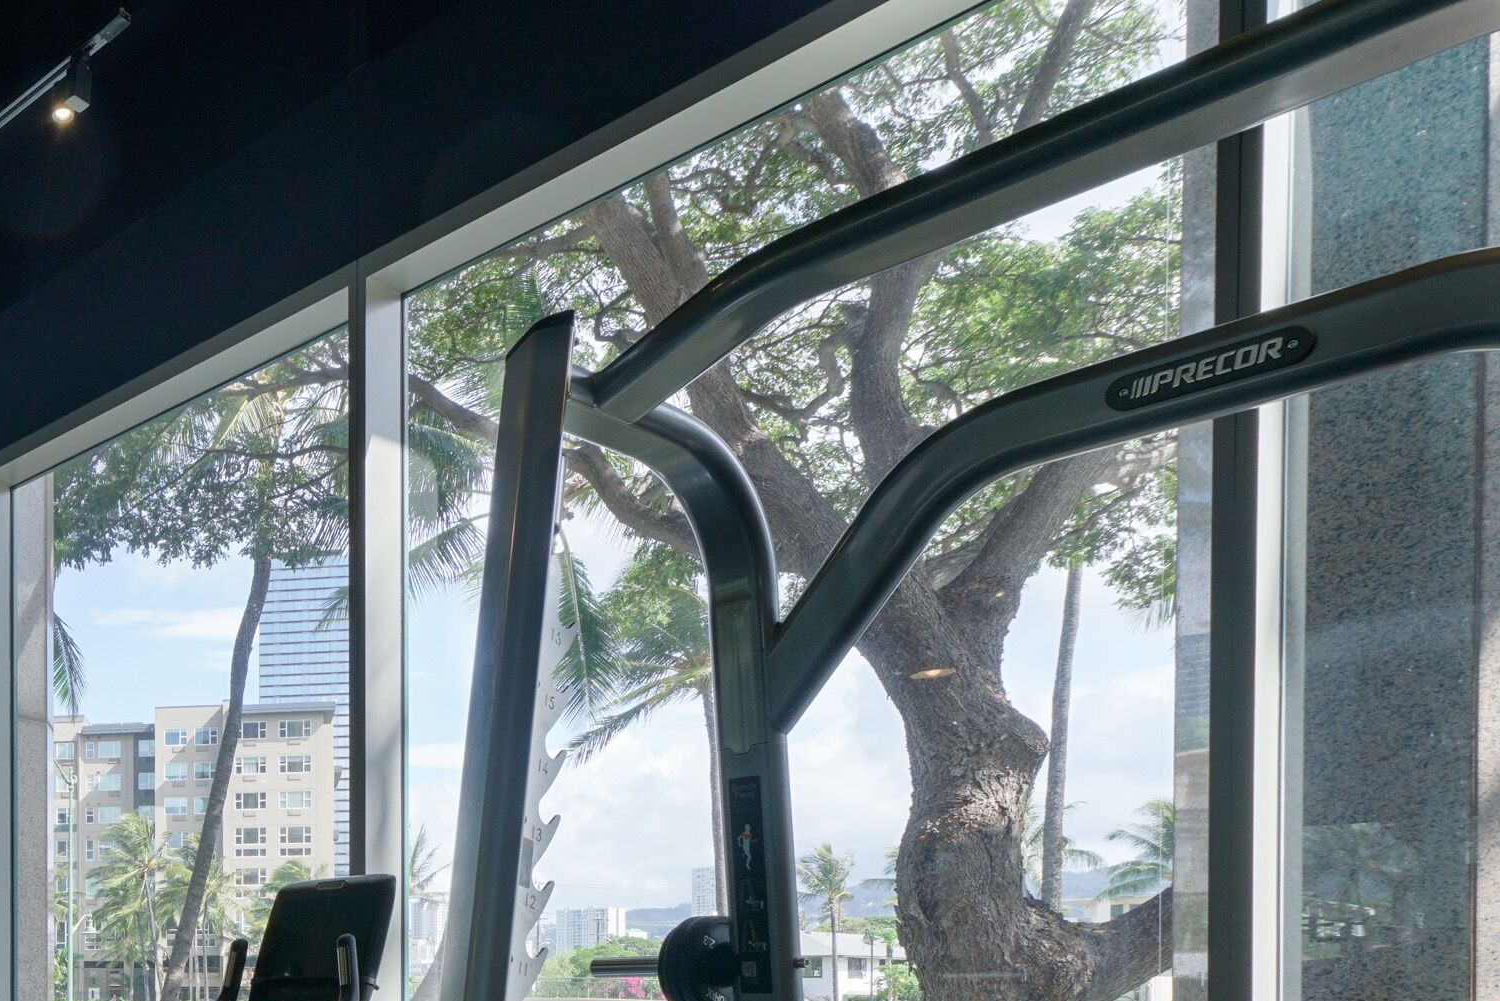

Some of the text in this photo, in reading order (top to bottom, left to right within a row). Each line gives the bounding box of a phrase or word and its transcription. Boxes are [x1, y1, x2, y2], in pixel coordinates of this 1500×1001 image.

[1151, 337, 1283, 395] PRECOR
[545, 693, 555, 710] 15
[538, 758, 549, 776] 14
[532, 825, 542, 842] 13
[526, 892, 536, 910] 12
